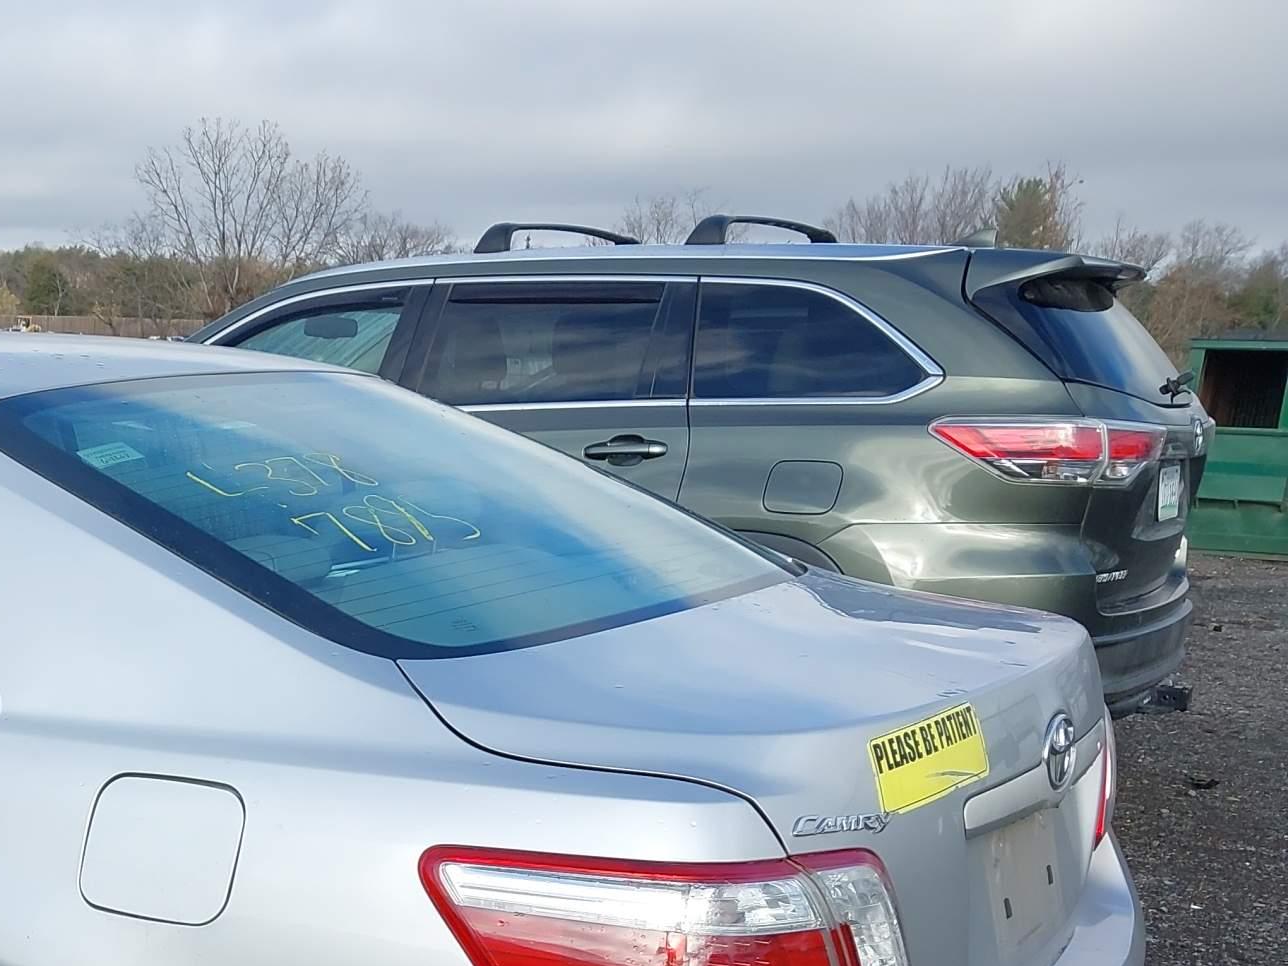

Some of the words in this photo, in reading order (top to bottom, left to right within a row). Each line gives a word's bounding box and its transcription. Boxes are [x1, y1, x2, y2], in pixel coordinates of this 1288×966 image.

[873, 729, 923, 774] PLEASE
[922, 722, 939, 756] BE
[938, 706, 977, 750] PATIENT
